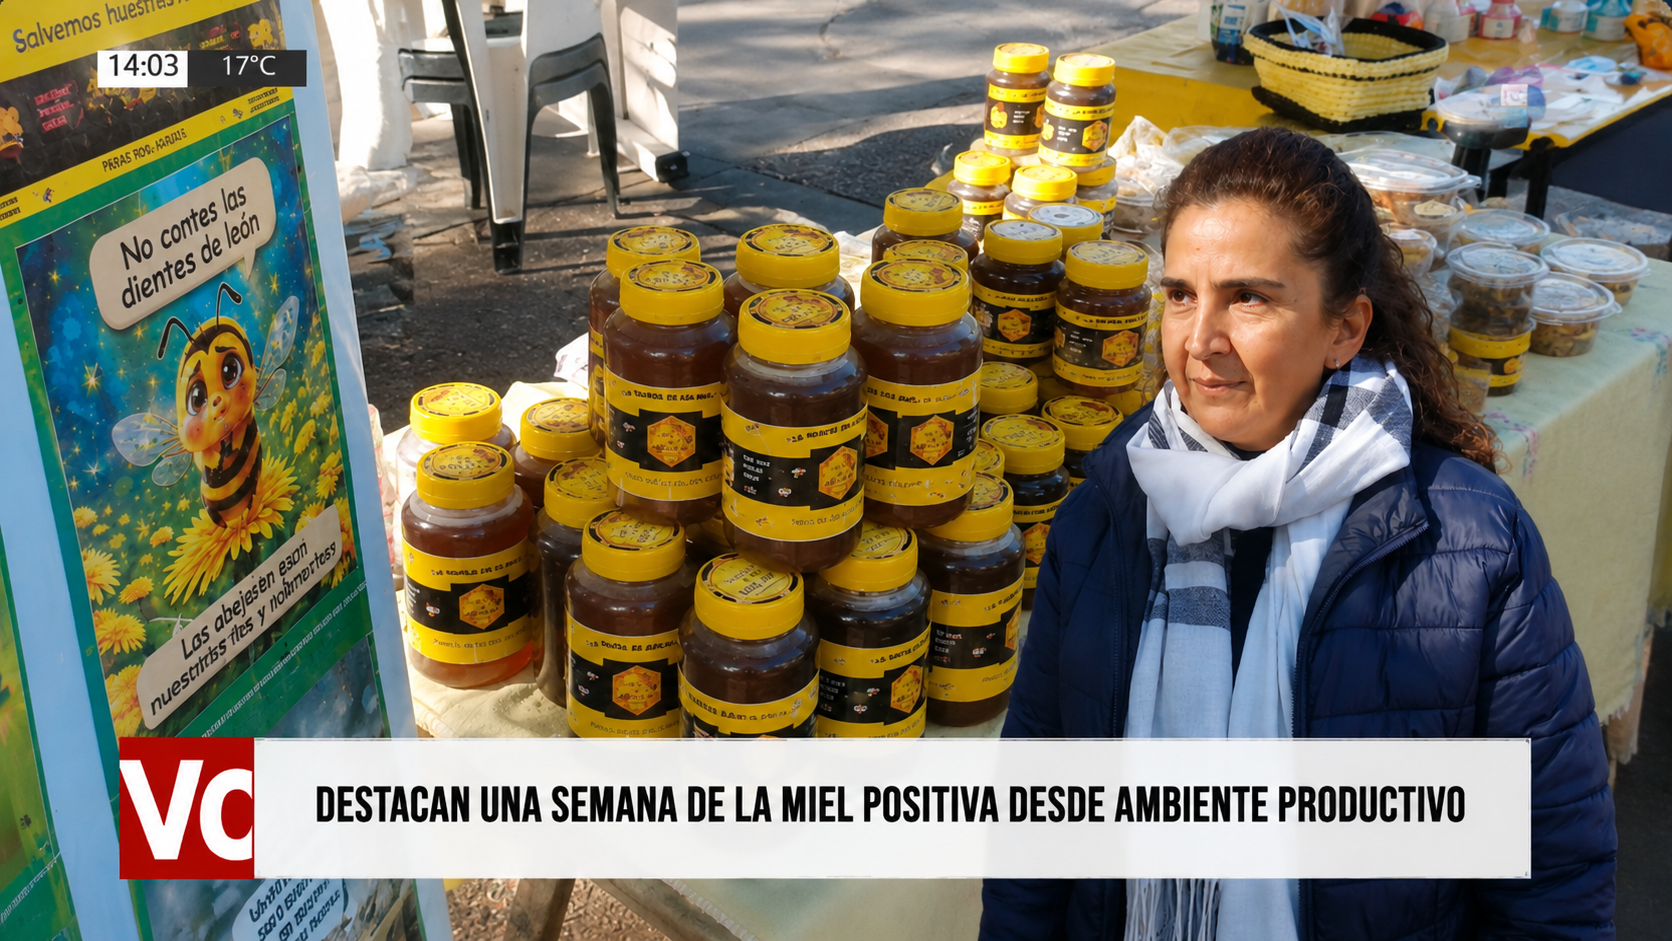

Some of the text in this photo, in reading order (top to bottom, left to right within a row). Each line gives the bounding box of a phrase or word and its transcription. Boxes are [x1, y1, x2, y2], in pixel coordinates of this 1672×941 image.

[13, 11, 101, 53] Salvemos
[120, 186, 247, 270] No contes las
[121, 211, 260, 309] dientes de león
[257, 605, 265, 627] y
